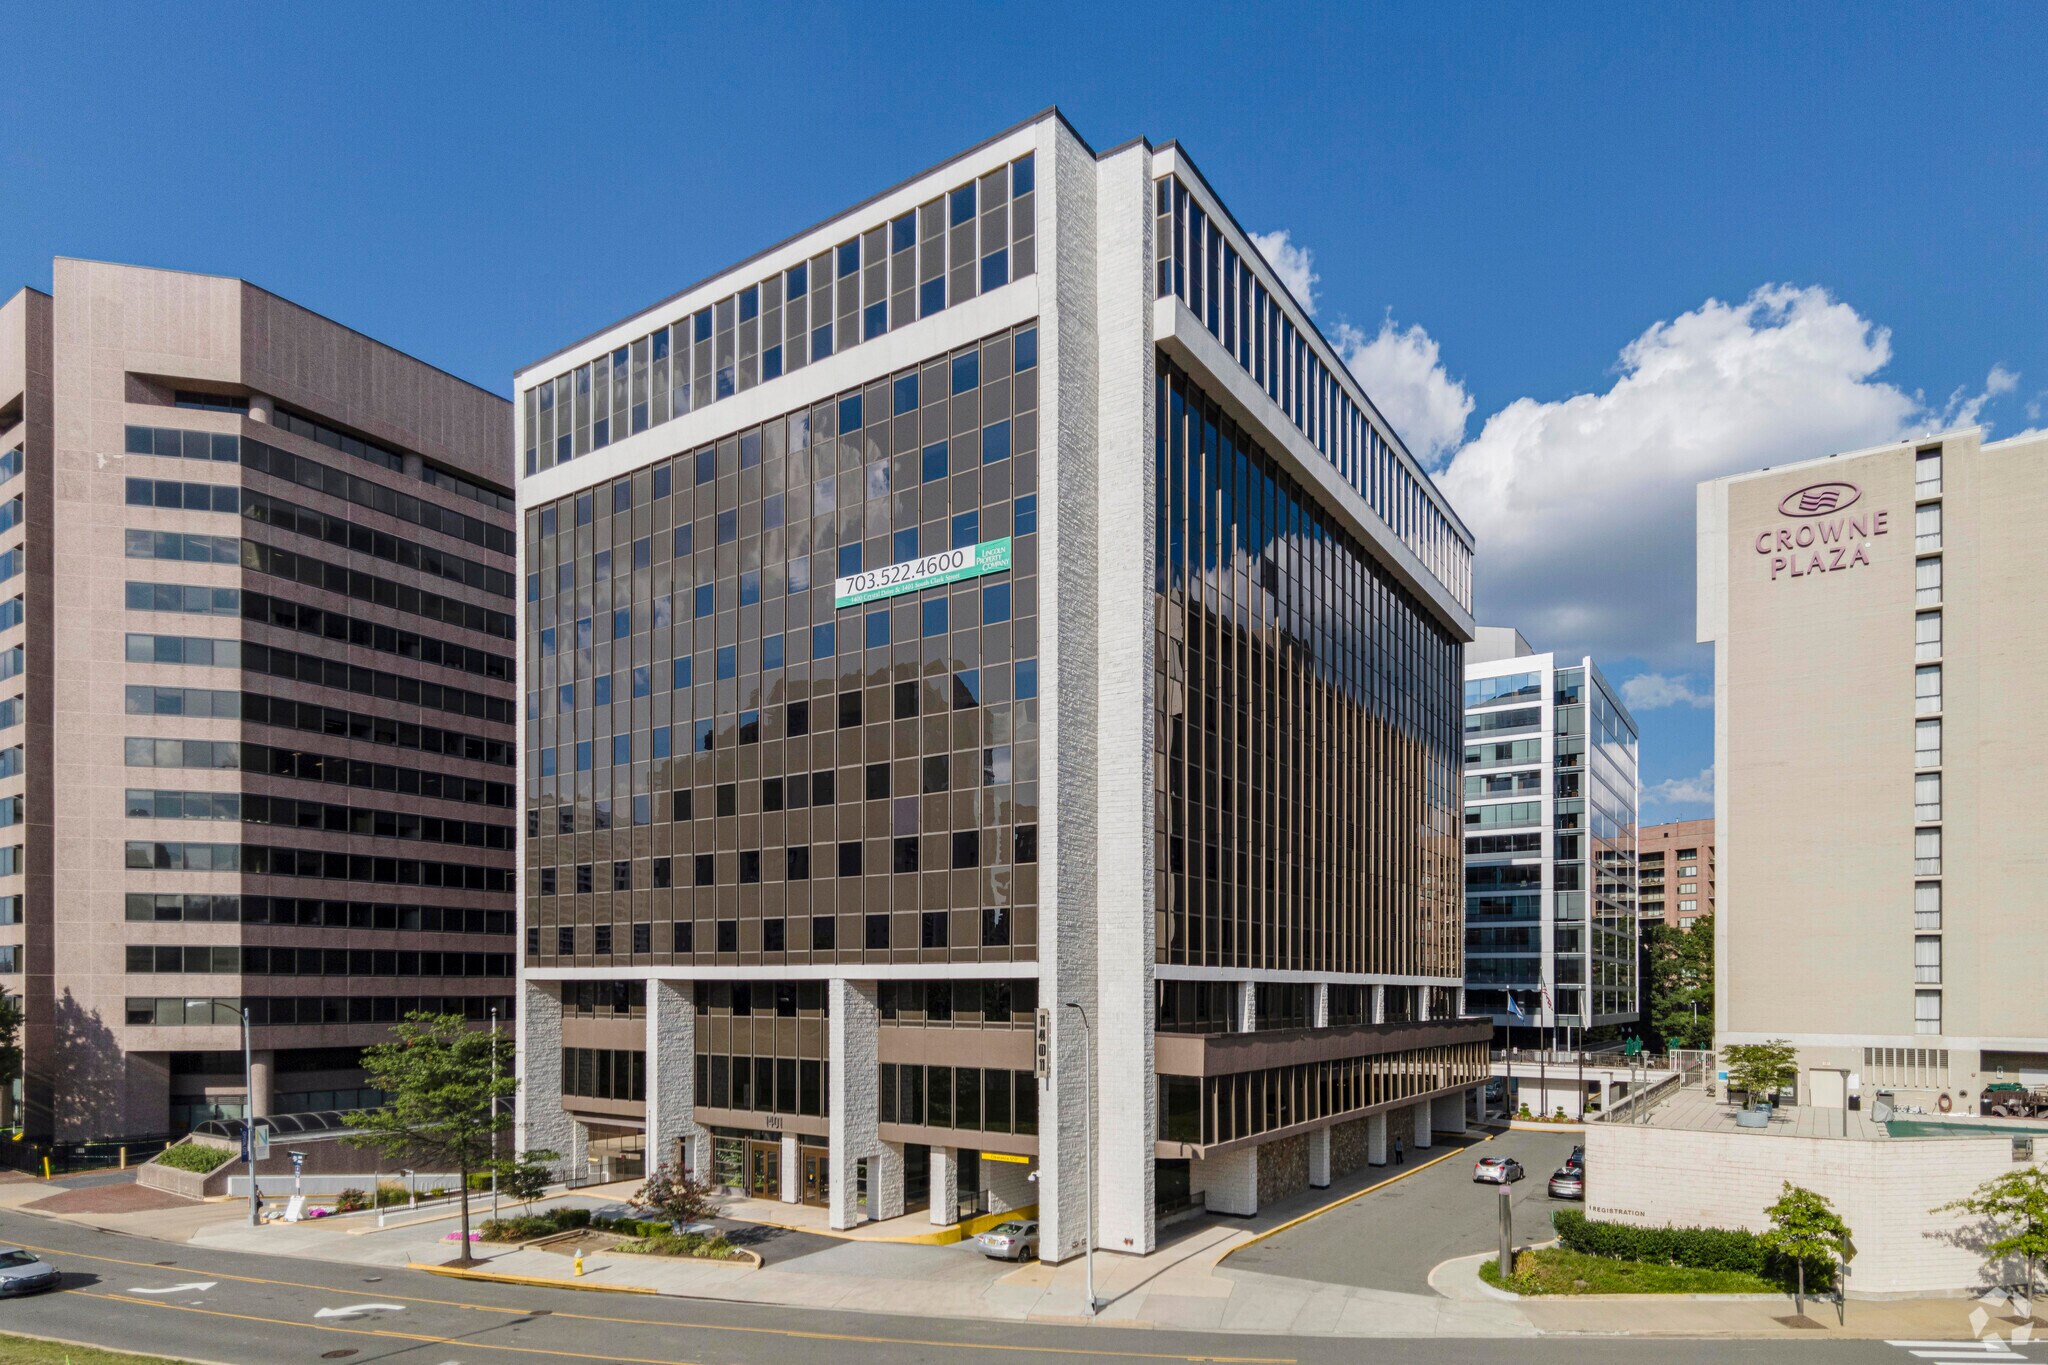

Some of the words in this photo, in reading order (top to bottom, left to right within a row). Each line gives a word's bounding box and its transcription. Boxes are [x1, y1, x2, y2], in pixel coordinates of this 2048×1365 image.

[1755, 510, 1888, 554] CROWNE
[976, 554, 1002, 565] PROPERTY
[982, 546, 1006, 558] LINCOLN
[982, 558, 1010, 572] COMPANY
[1771, 543, 1870, 581] PLAZA
[846, 550, 964, 595] 703.522.4600
[1038, 1014, 1047, 1072] 1401
[1592, 1206, 1646, 1217] REGISTRATION
